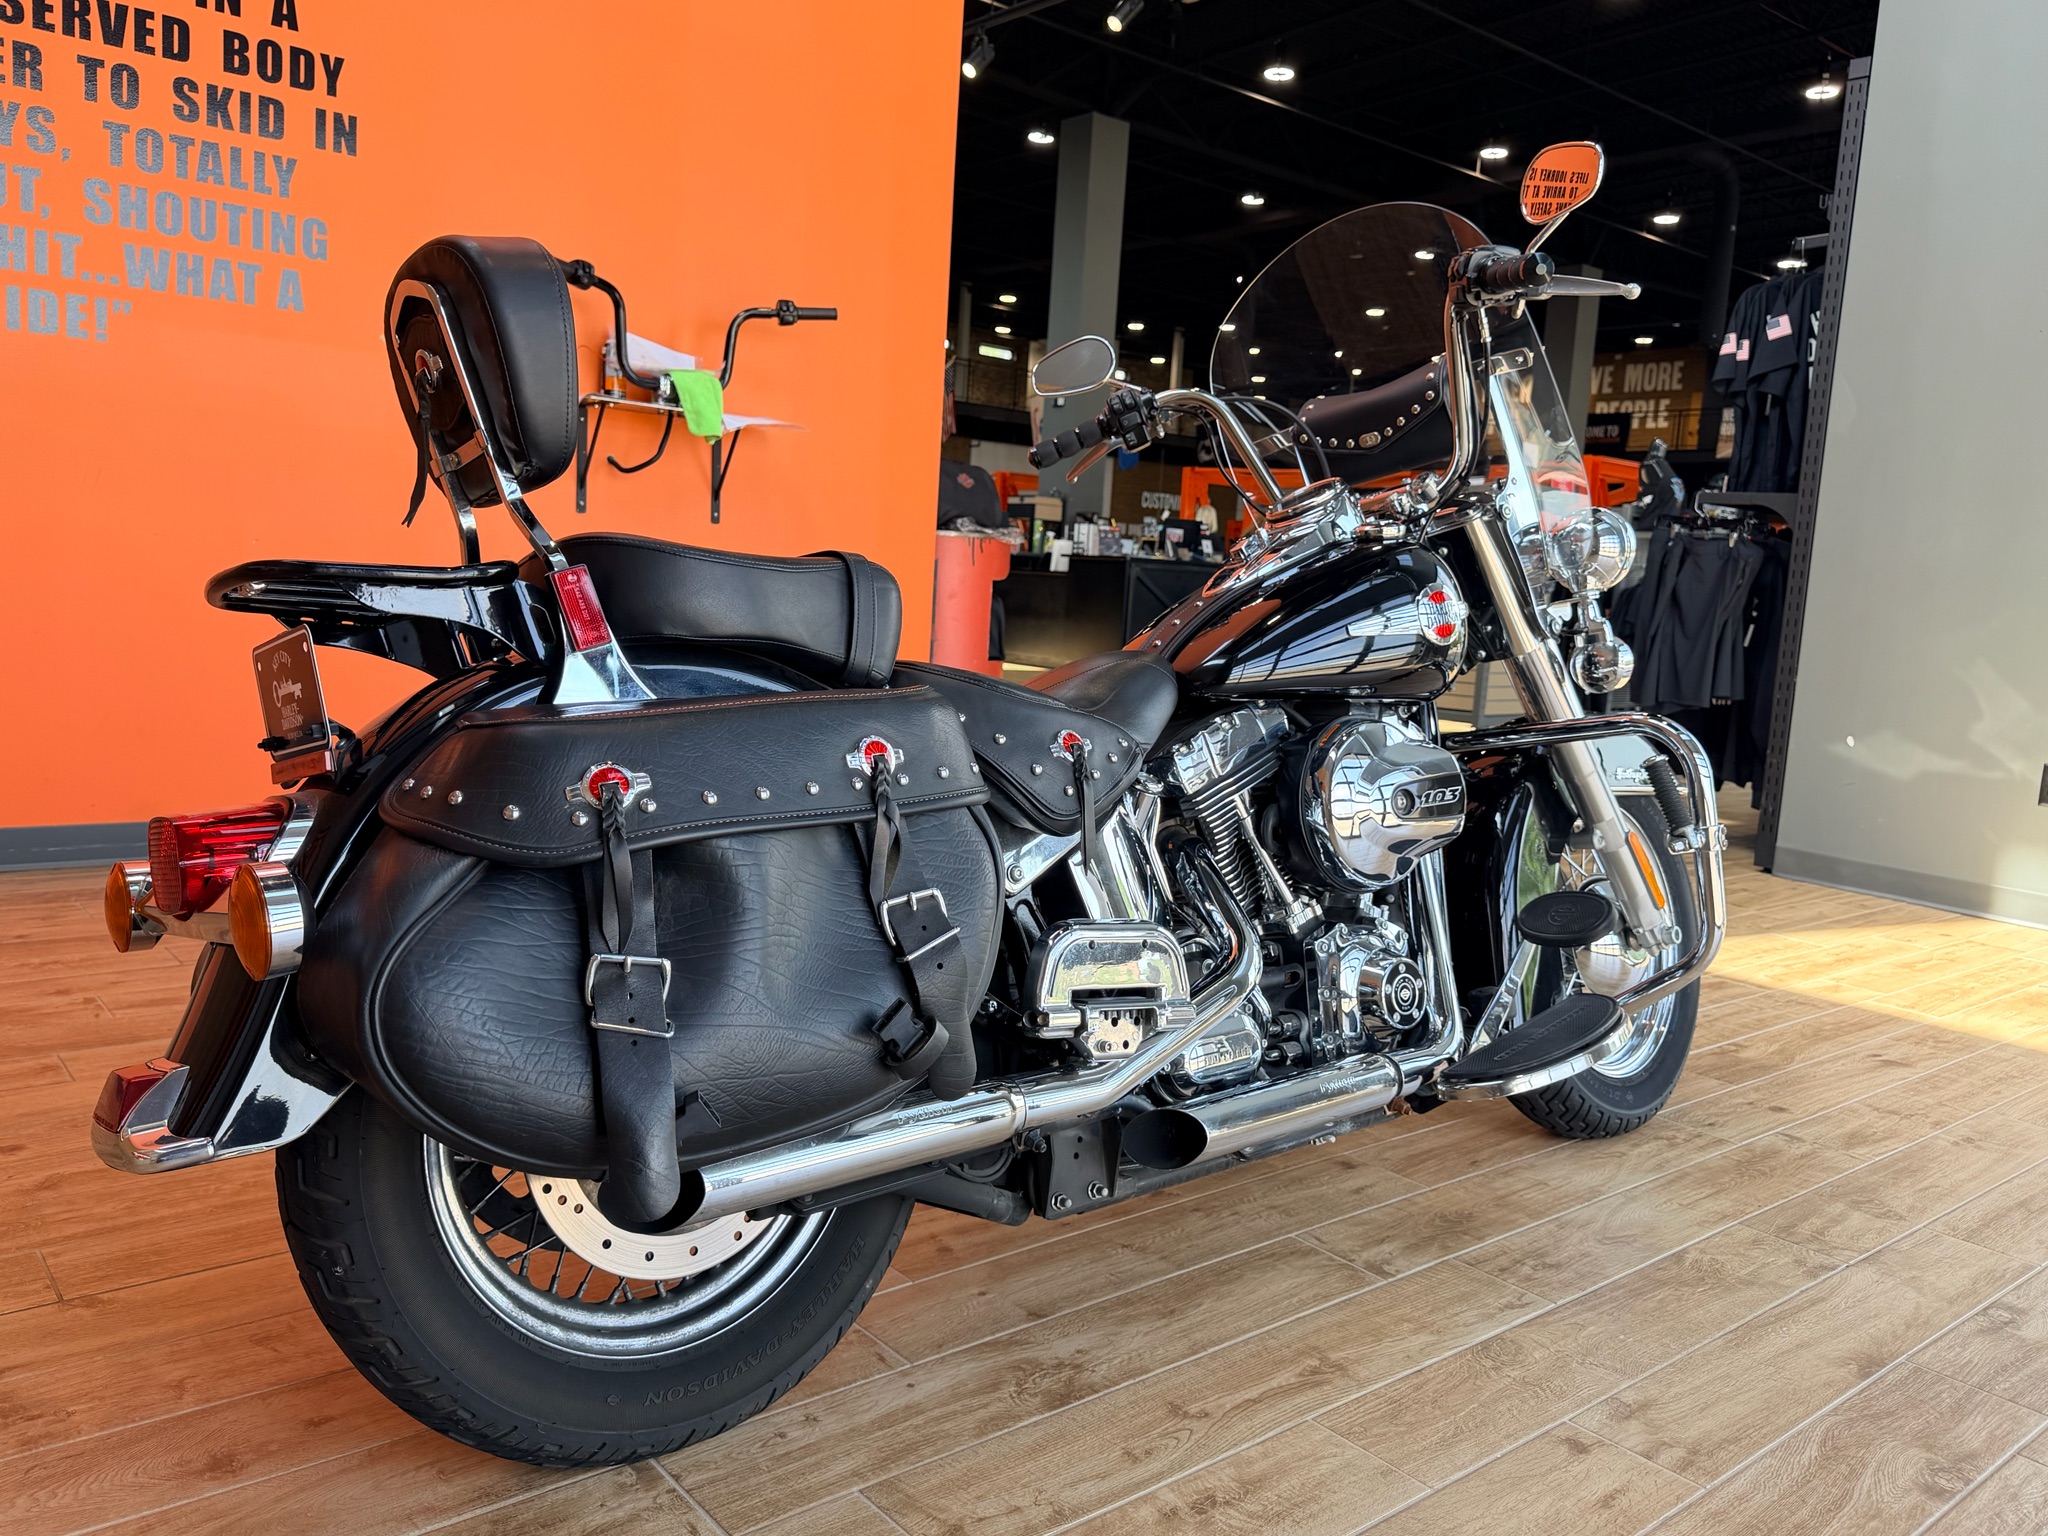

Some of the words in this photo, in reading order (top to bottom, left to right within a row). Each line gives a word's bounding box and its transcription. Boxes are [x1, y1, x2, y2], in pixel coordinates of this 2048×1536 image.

[0, 37, 43, 91] R
[77, 54, 140, 111] TO
[172, 76, 285, 141] SKID
[315, 107, 357, 157] IN
[223, 29, 345, 98] BODY
[102, 119, 299, 199] TOTALLY
[0, 162, 51, 220] T,
[82, 177, 329, 262] SHOUTING
[277, 269, 305, 312] A
[1623, 360, 1684, 394] MORE
[1421, 786, 1462, 808] 103
